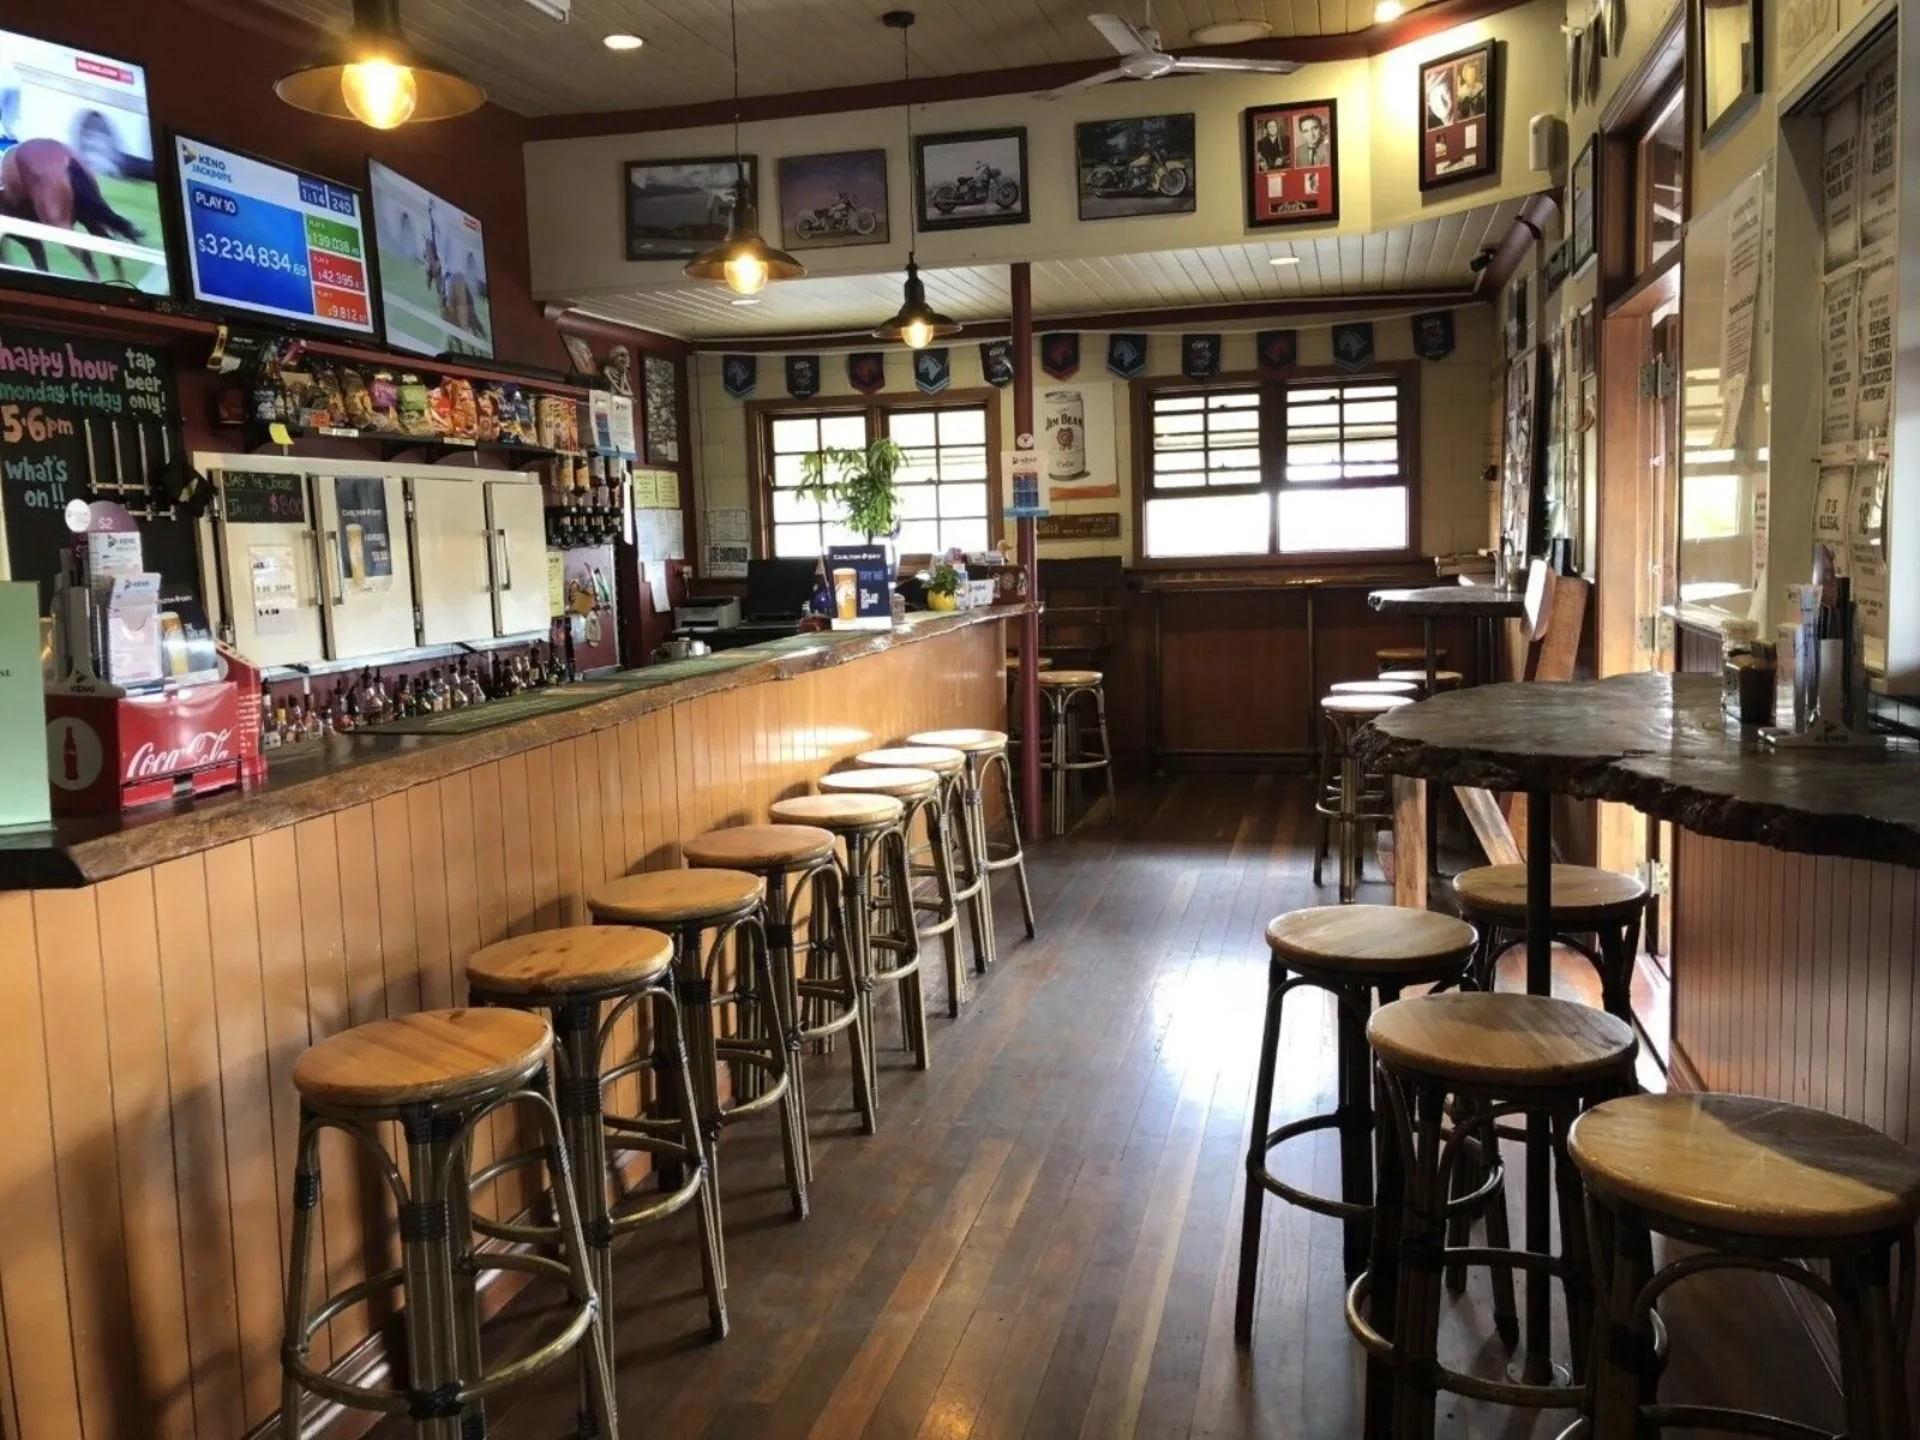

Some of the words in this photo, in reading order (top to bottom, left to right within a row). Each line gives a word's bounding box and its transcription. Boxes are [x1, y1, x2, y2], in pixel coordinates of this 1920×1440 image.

[198, 155, 226, 171] KENO
[192, 165, 232, 184] JACKPOTS
[195, 191, 222, 209] PLAY
[223, 199, 236, 214] 10
[302, 188, 326, 206] 1:14
[332, 197, 352, 214] 240
[0, 337, 64, 379] happy
[64, 341, 119, 382] hour
[125, 347, 157, 374] tap
[123, 369, 162, 393] beer
[128, 390, 168, 416] only!
[1045, 416, 1059, 431] JIM
[4, 455, 68, 483] what's
[69, 684, 97, 694] KENO
